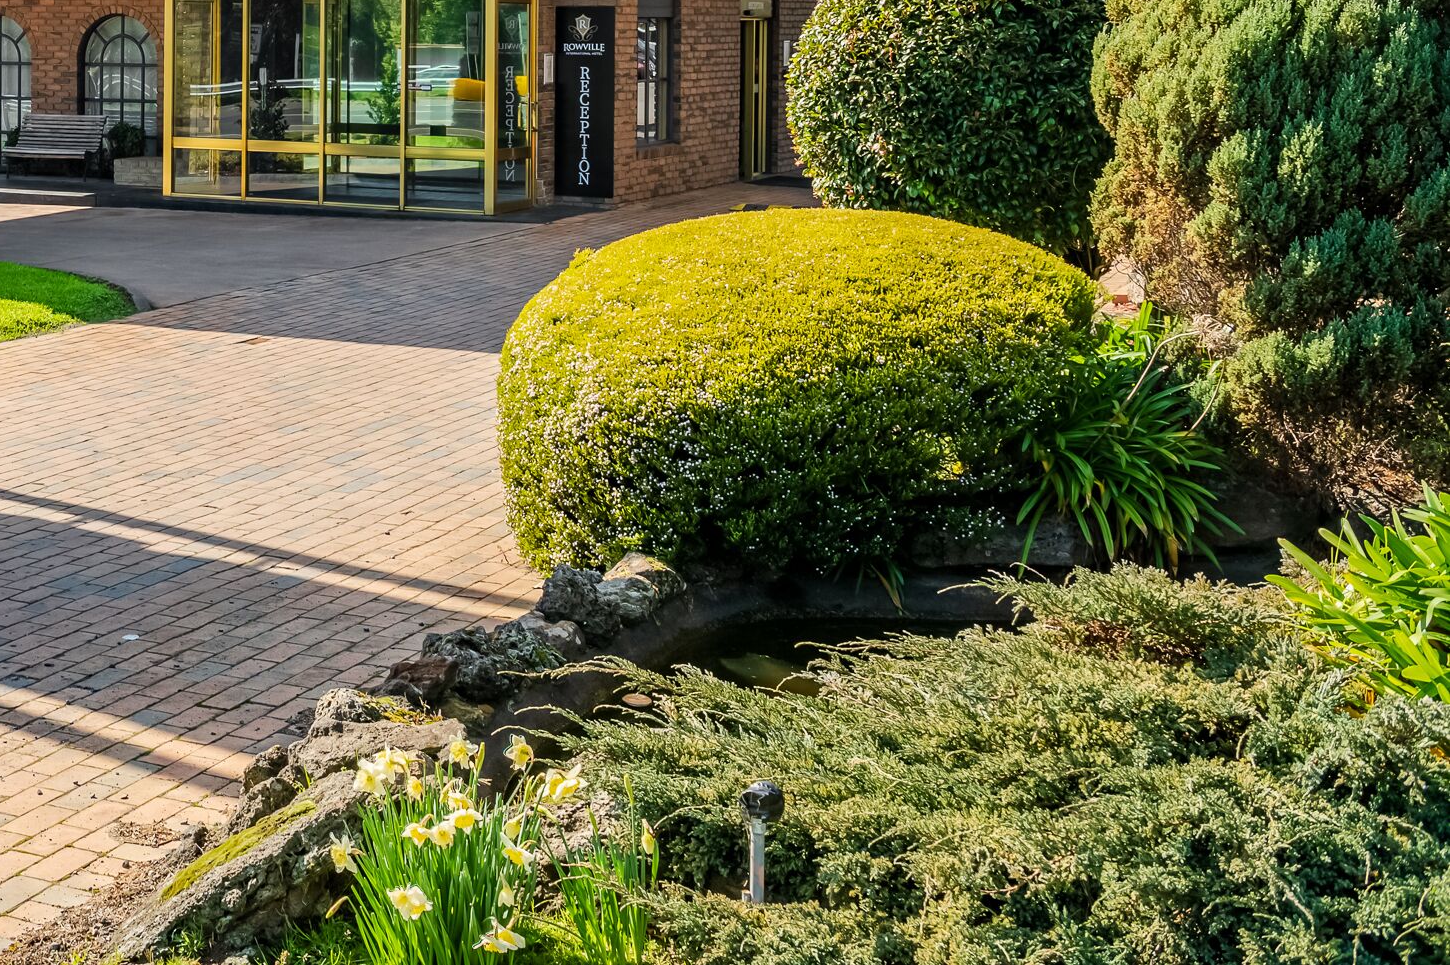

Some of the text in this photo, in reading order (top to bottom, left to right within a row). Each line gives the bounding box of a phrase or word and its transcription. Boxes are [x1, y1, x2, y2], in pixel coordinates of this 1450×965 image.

[579, 19, 587, 29] R
[563, 43, 605, 52] ROWVILLE
[578, 66, 591, 186] RECEPTION
